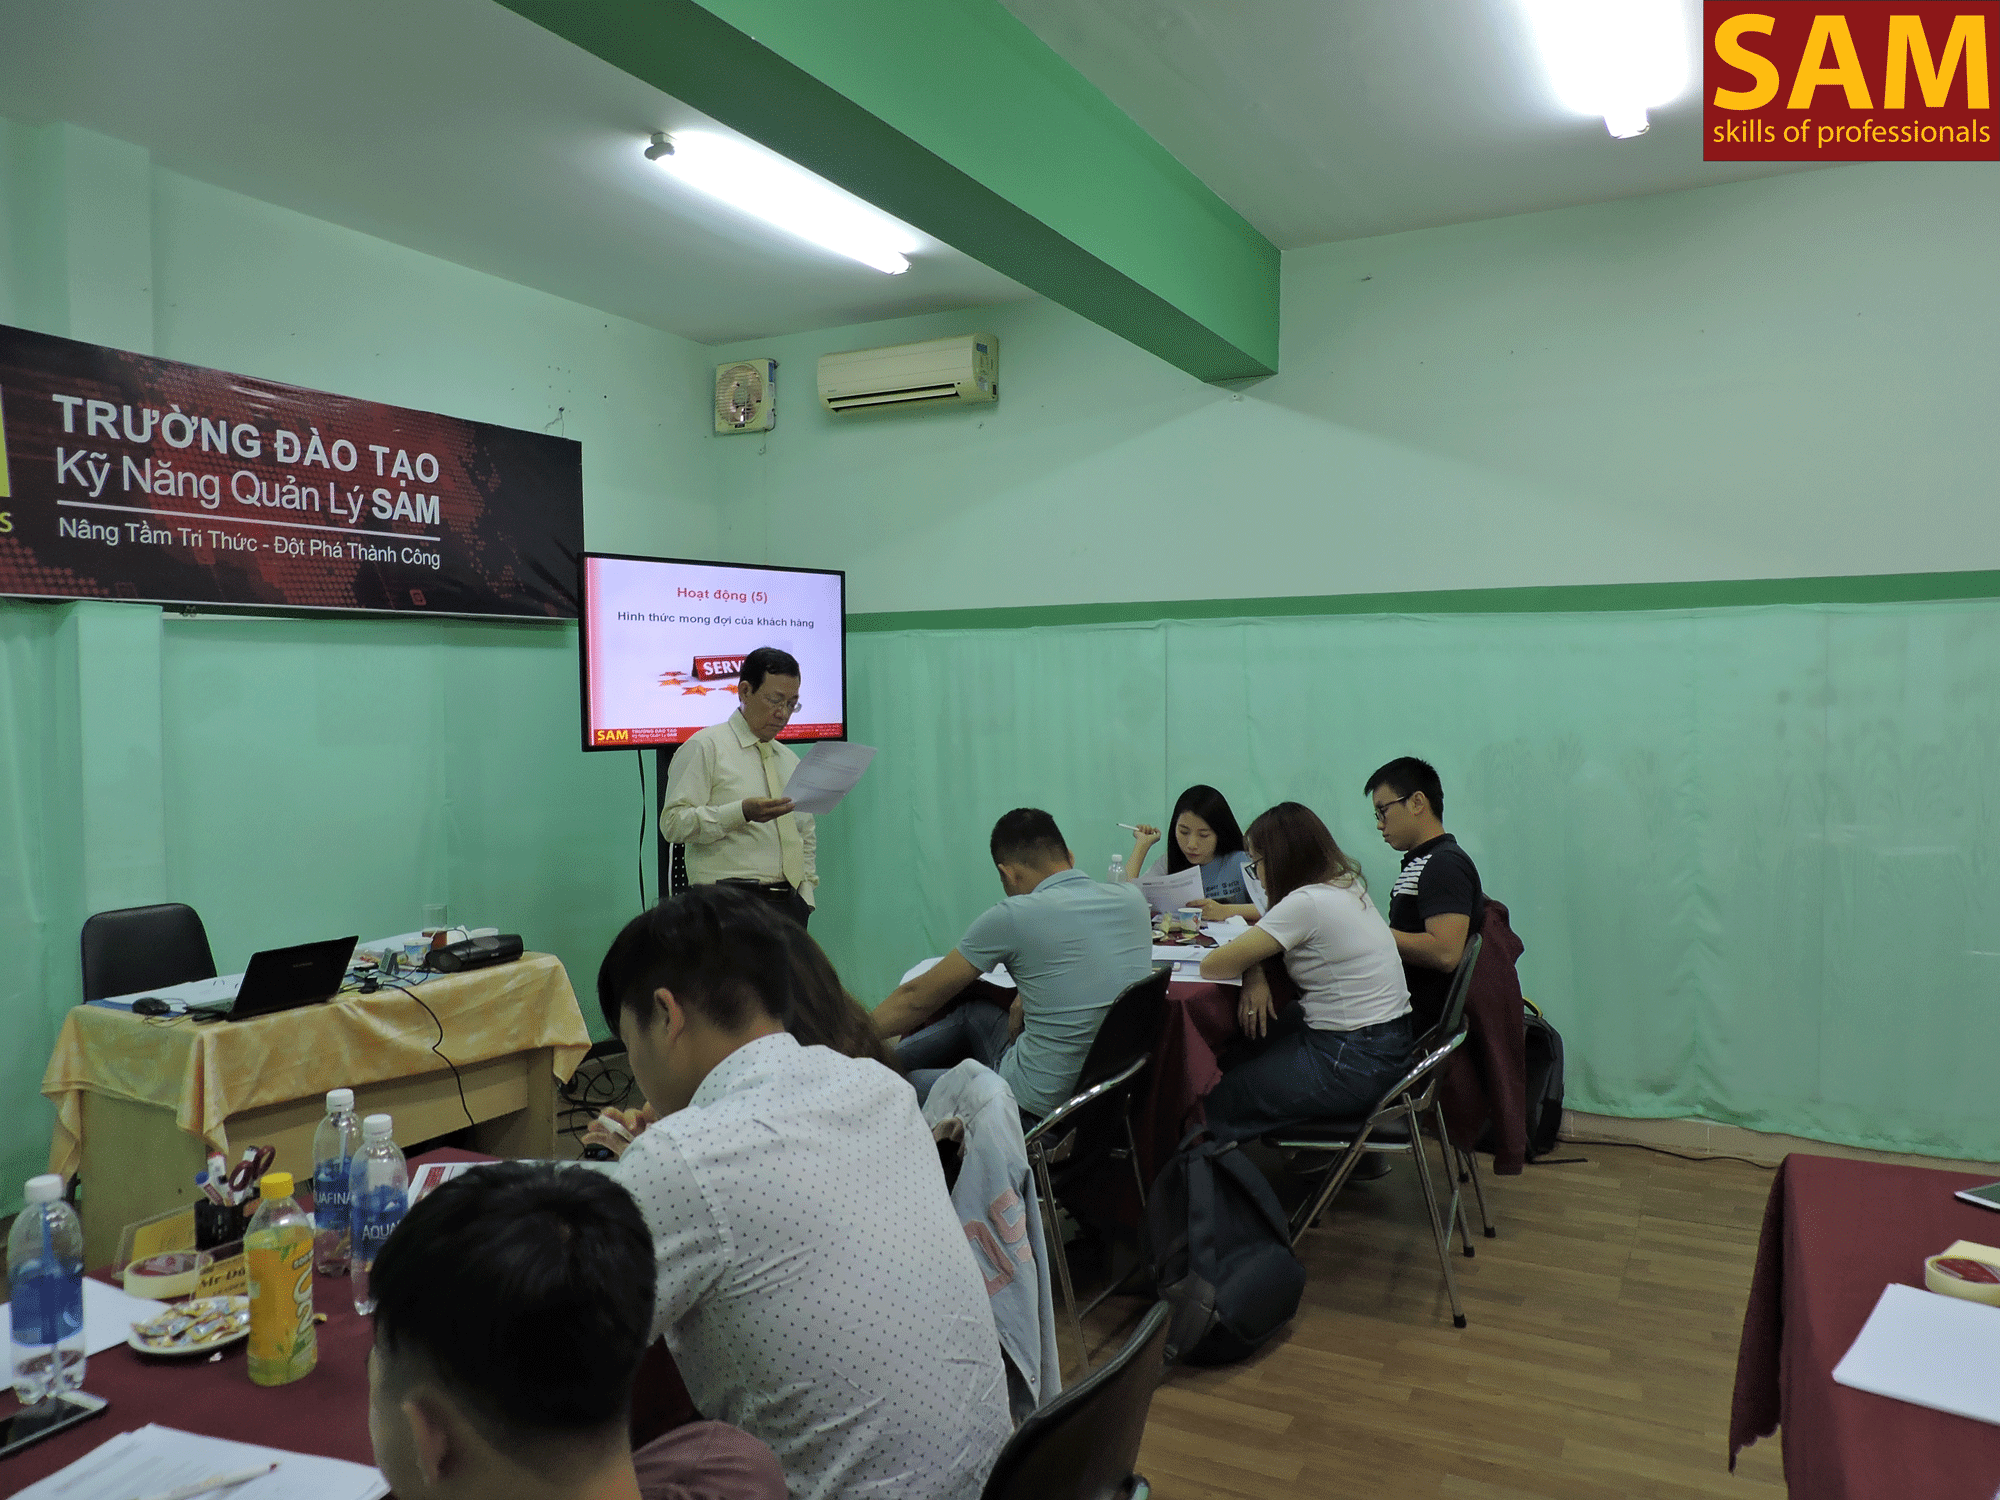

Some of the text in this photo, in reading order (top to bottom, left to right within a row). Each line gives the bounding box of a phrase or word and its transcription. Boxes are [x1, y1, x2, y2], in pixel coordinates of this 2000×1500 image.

[52, 393, 440, 487] TRƯỜNG ĐÀO TẠO
[56, 446, 440, 525] Kỹ Năng Quản Lý SAM
[58, 516, 120, 547] Nâng
[124, 519, 173, 546] Tầm
[207, 529, 258, 552] Thức
[273, 535, 306, 558] Đột
[310, 539, 343, 559] Phá
[347, 542, 398, 563] Thành
[401, 547, 441, 571] Công
[677, 587, 769, 605] Hoạt động (5)
[679, 614, 712, 626] mong
[757, 617, 788, 627] khách
[703, 659, 745, 676] SERV
[597, 729, 629, 741] SAM
